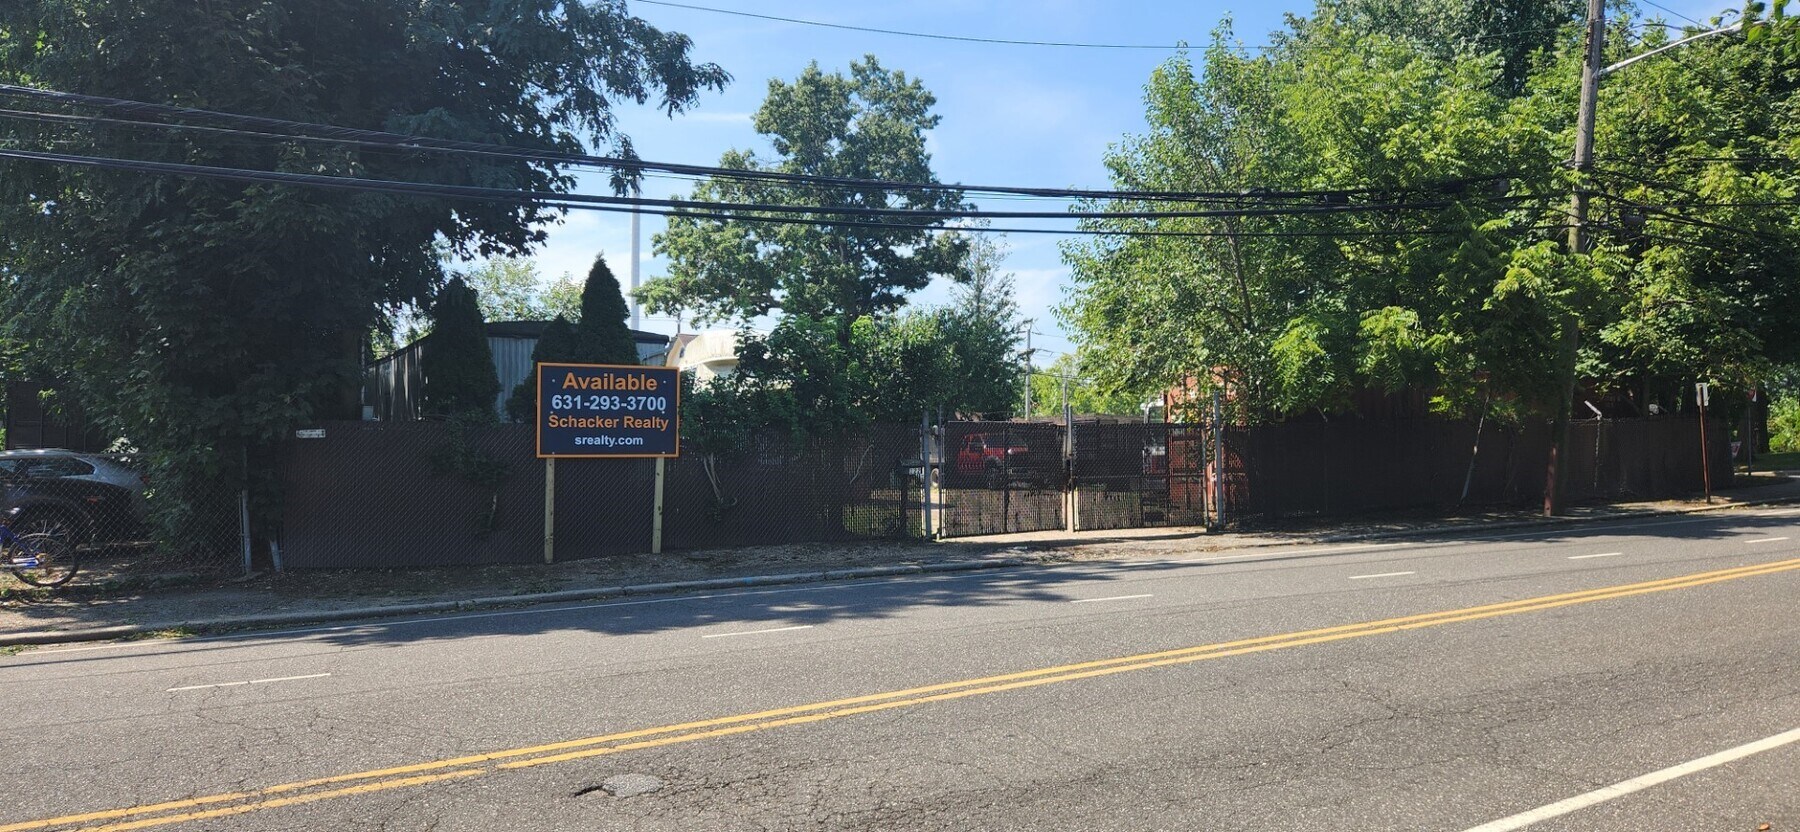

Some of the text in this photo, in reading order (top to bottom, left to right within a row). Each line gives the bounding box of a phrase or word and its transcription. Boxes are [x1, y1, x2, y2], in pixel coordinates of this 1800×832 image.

[562, 372, 658, 391] Available
[551, 394, 667, 411] 631-293-3700
[548, 415, 669, 431] Schacker Realty
[574, 435, 643, 447] srealty.com
